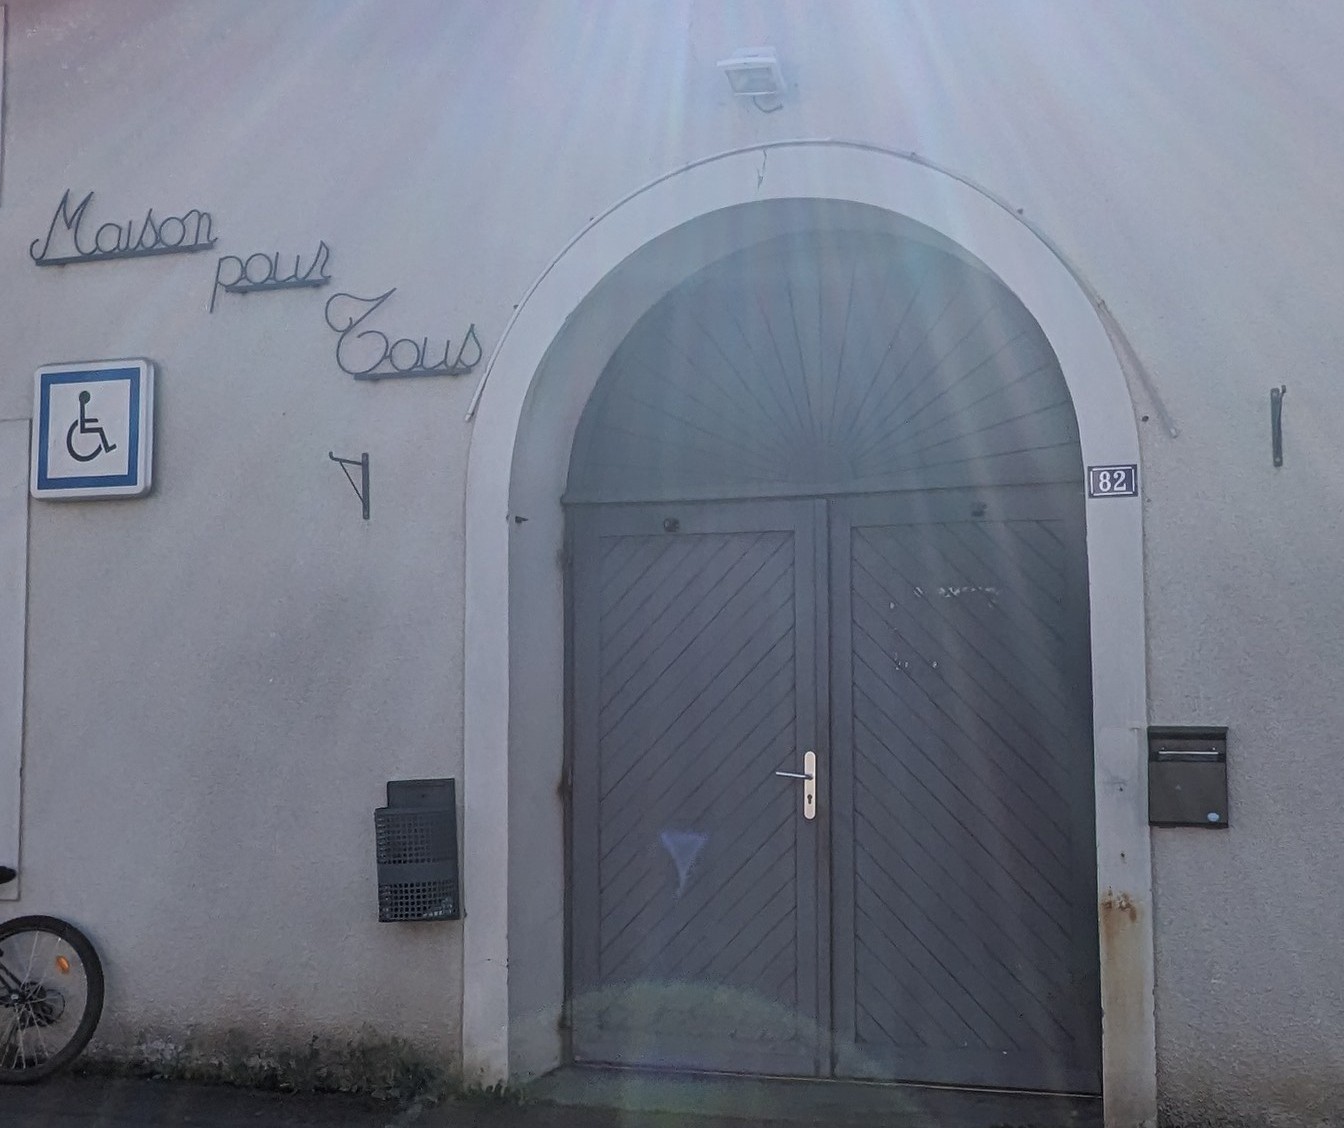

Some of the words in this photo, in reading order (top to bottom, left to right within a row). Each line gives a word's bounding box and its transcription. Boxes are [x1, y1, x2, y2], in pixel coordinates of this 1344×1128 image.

[29, 188, 218, 262] Maison
[209, 240, 332, 314] pour
[325, 287, 483, 375] Tous
[1098, 470, 1127, 492] 82
